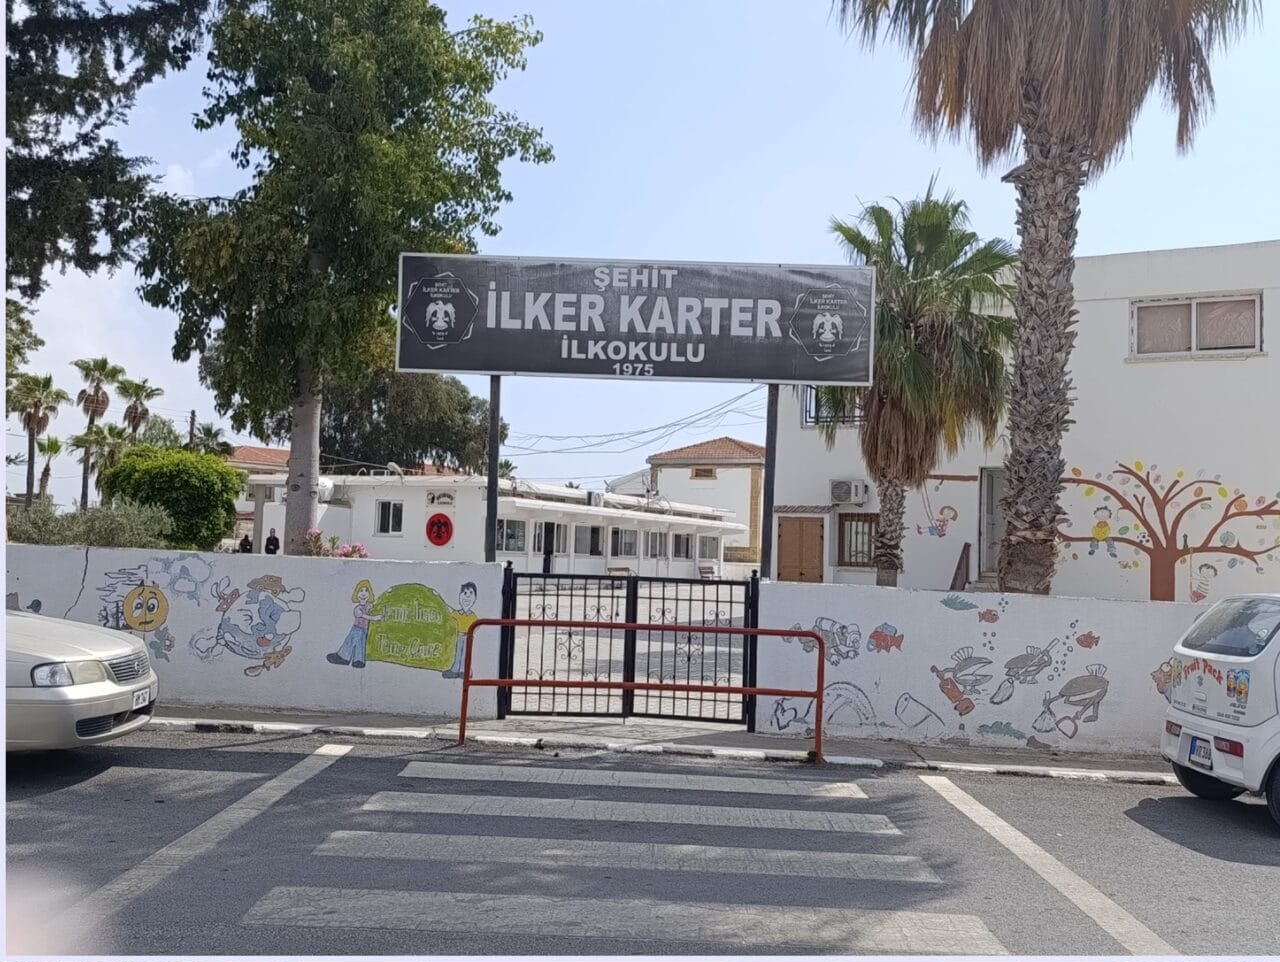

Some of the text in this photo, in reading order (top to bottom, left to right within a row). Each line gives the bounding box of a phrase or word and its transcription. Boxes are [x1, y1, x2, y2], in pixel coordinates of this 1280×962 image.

[593, 266, 678, 292] ŞEHİT
[486, 281, 783, 338] İLKER KARTER
[561, 334, 706, 363] İLKOKULU
[612, 363, 655, 376] 1975
